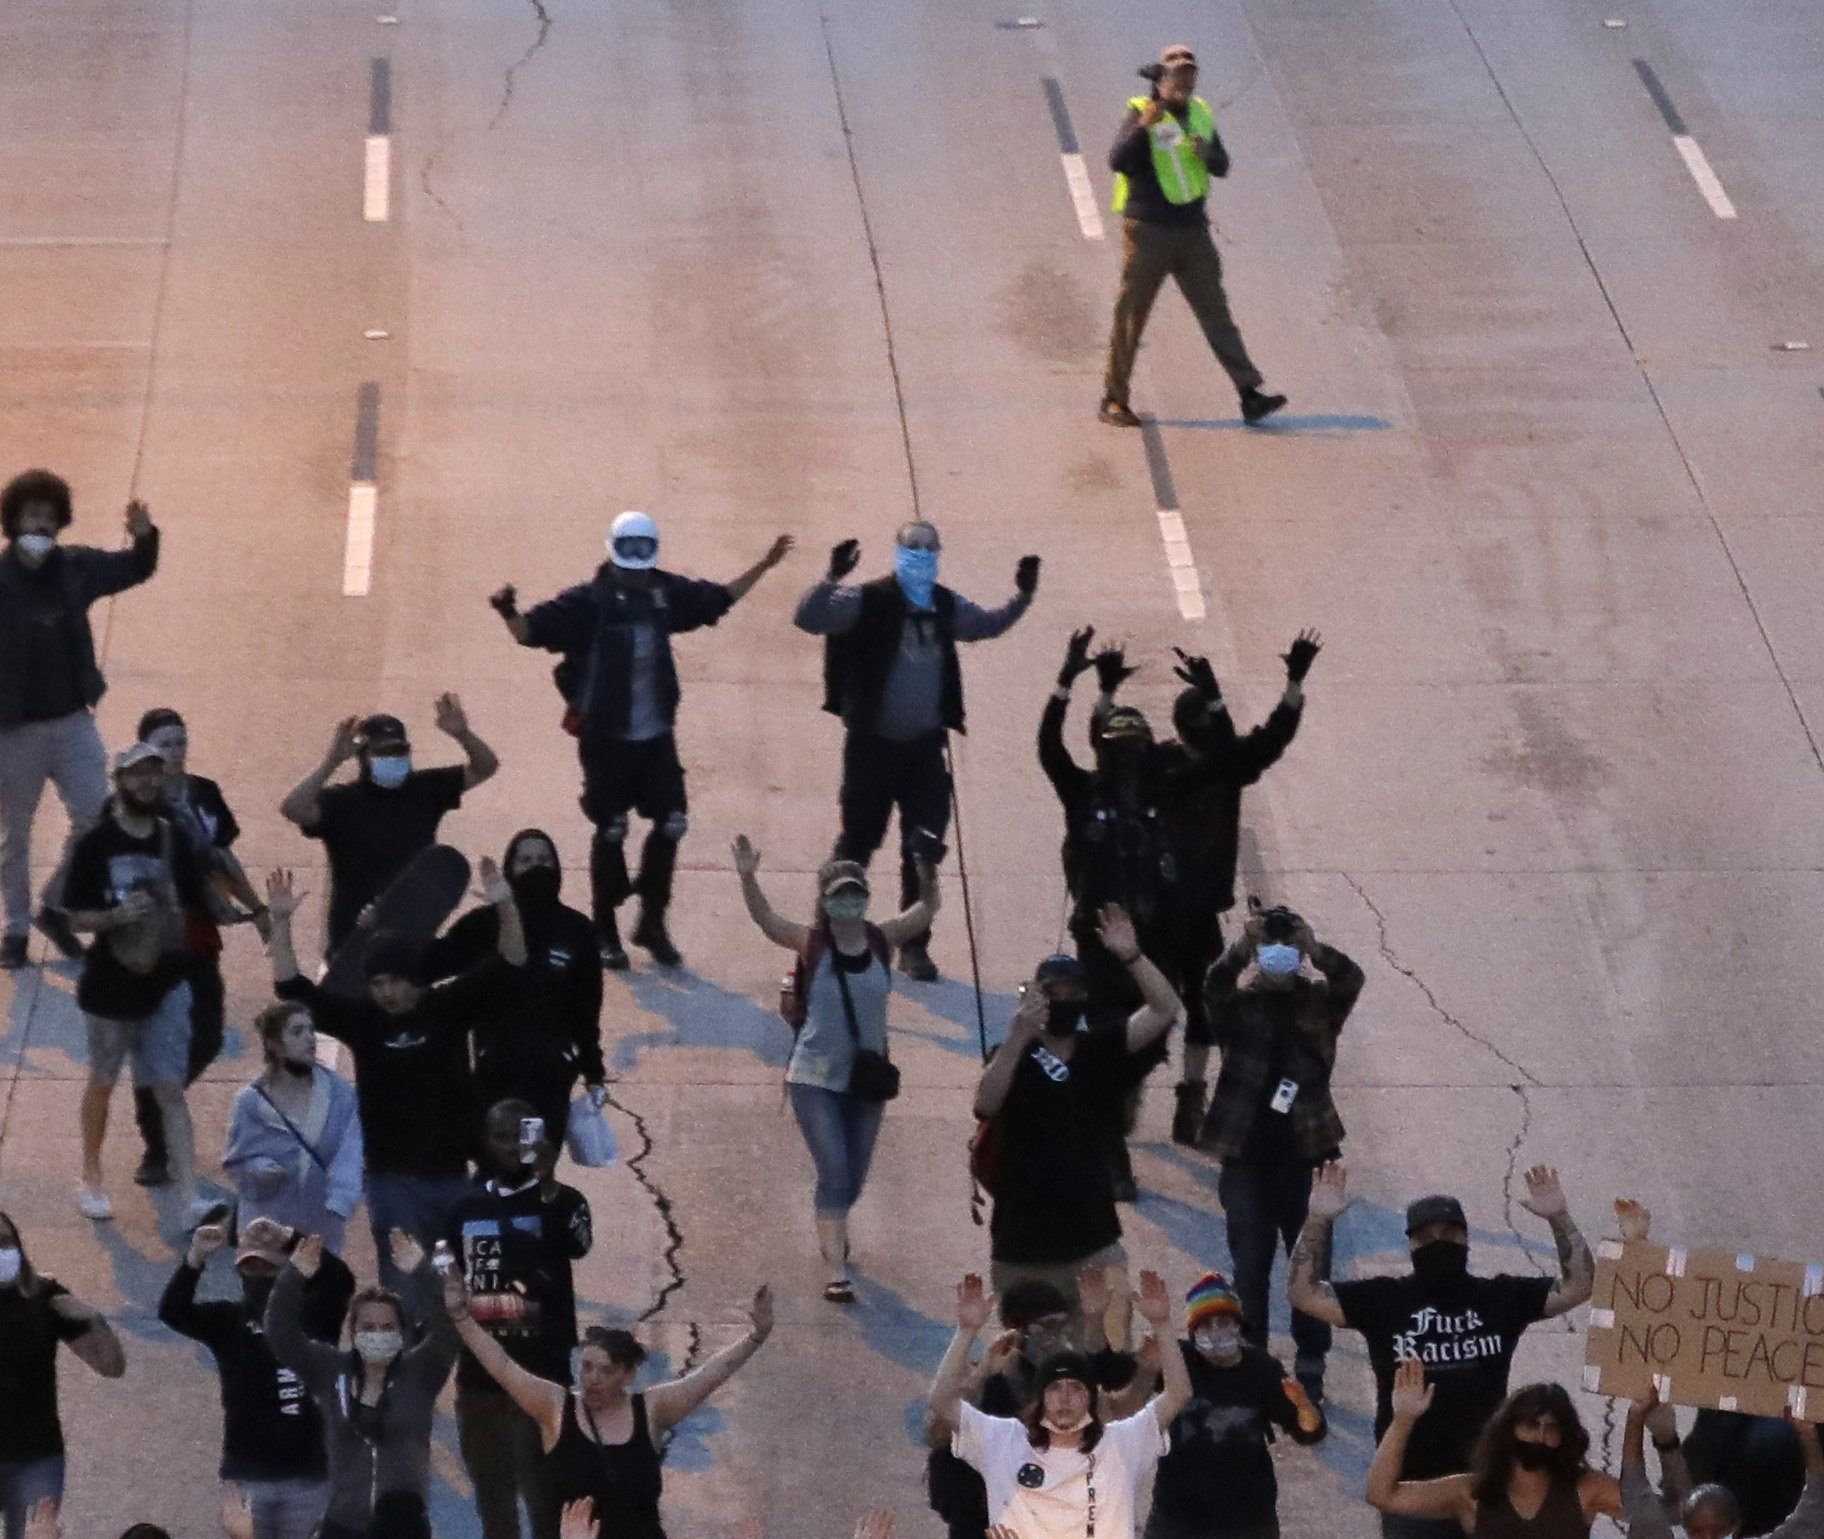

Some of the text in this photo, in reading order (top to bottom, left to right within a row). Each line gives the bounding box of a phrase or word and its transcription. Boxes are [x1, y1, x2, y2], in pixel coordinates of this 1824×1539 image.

[1612, 1272, 1674, 1313] NO
[1405, 1306, 1484, 1336] Fuck
[1392, 1333, 1502, 1362] Racism
[1617, 1322, 1680, 1363] NO
